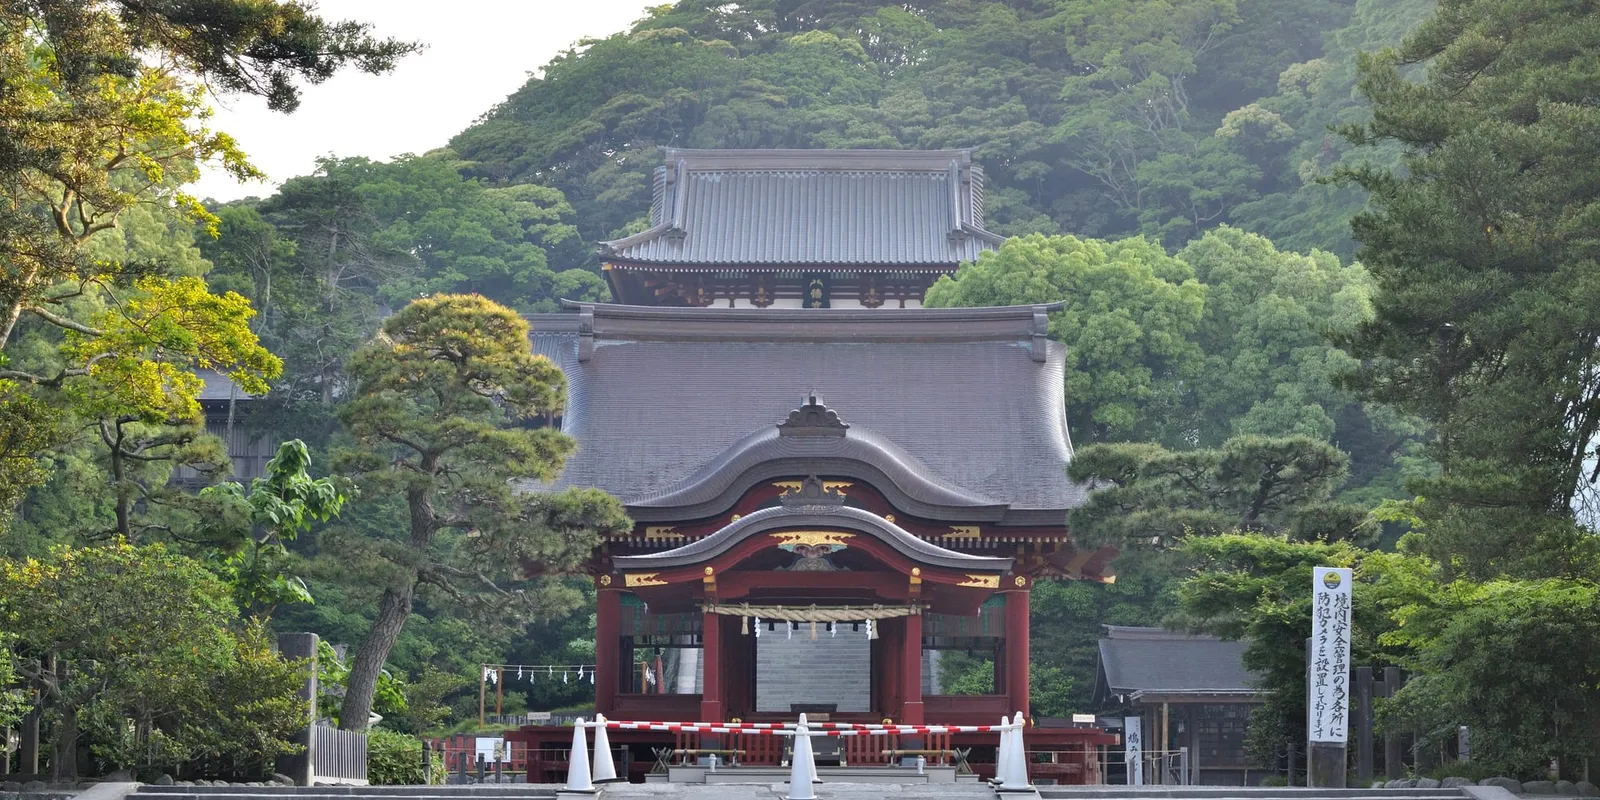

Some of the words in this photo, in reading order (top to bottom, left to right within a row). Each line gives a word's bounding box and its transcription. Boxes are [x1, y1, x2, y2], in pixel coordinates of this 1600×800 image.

[1313, 592, 1332, 739] 防犯カメラを設置しております
